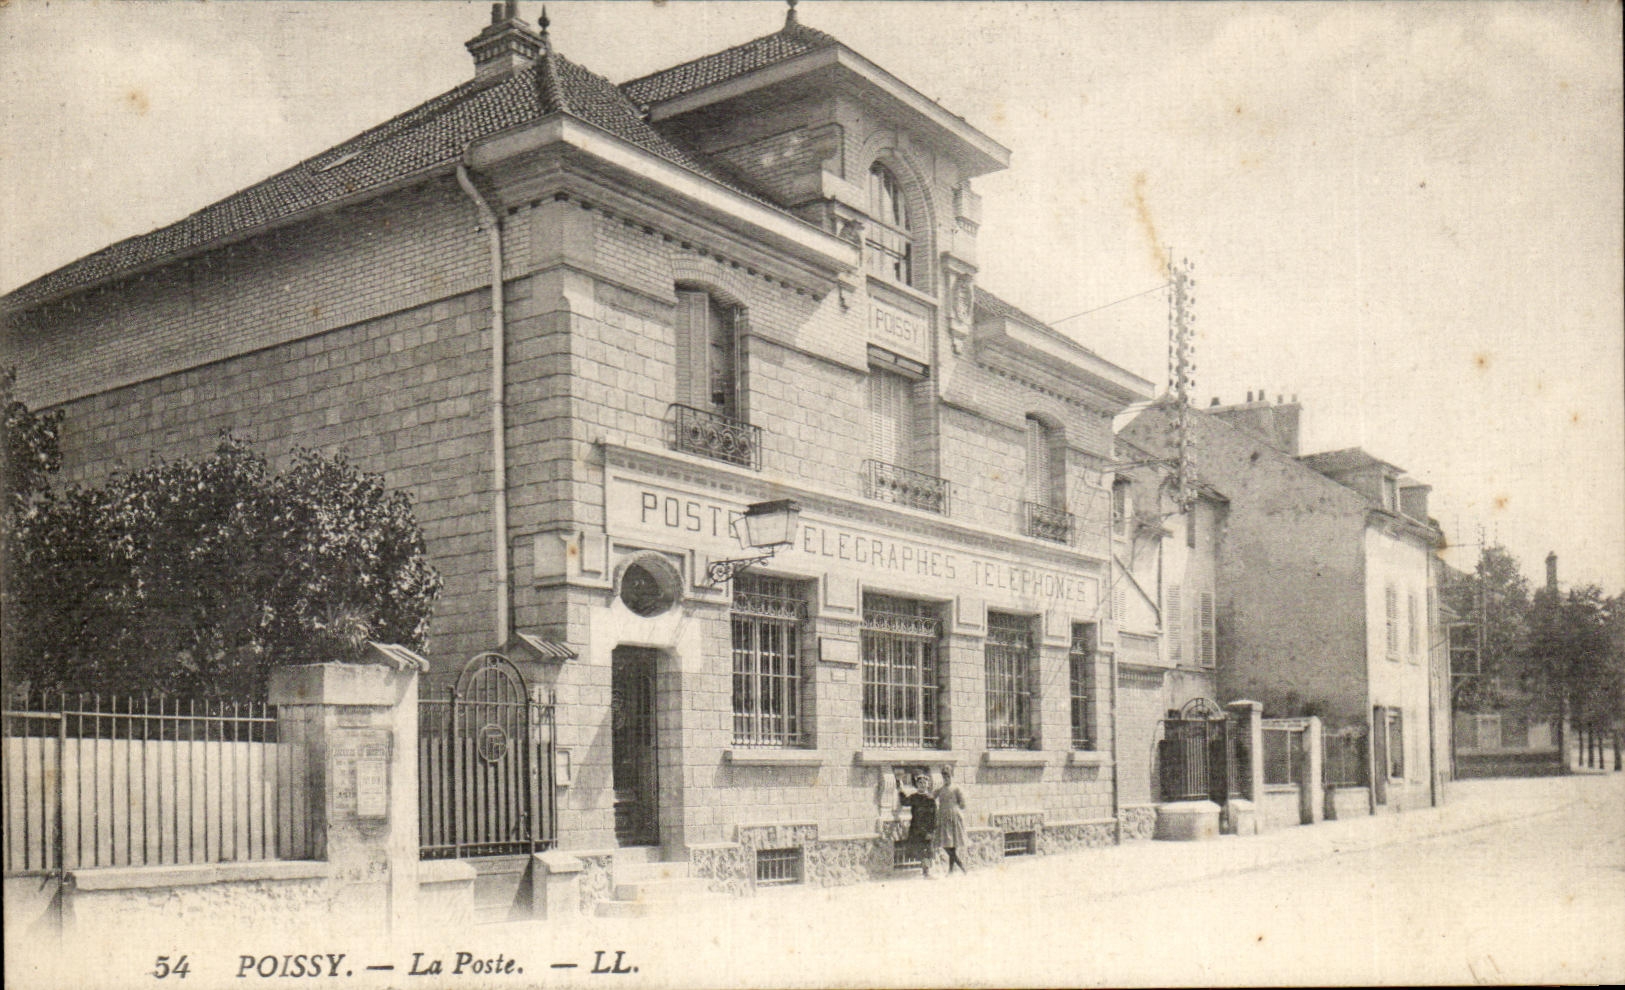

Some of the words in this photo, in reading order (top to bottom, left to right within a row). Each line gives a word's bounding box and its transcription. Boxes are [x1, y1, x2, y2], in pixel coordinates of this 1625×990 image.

[876, 308, 919, 343] POISSY
[641, 491, 743, 541] POSTE
[797, 523, 957, 579] ELEGRAPHES
[972, 560, 1086, 602] TELEPHONES
